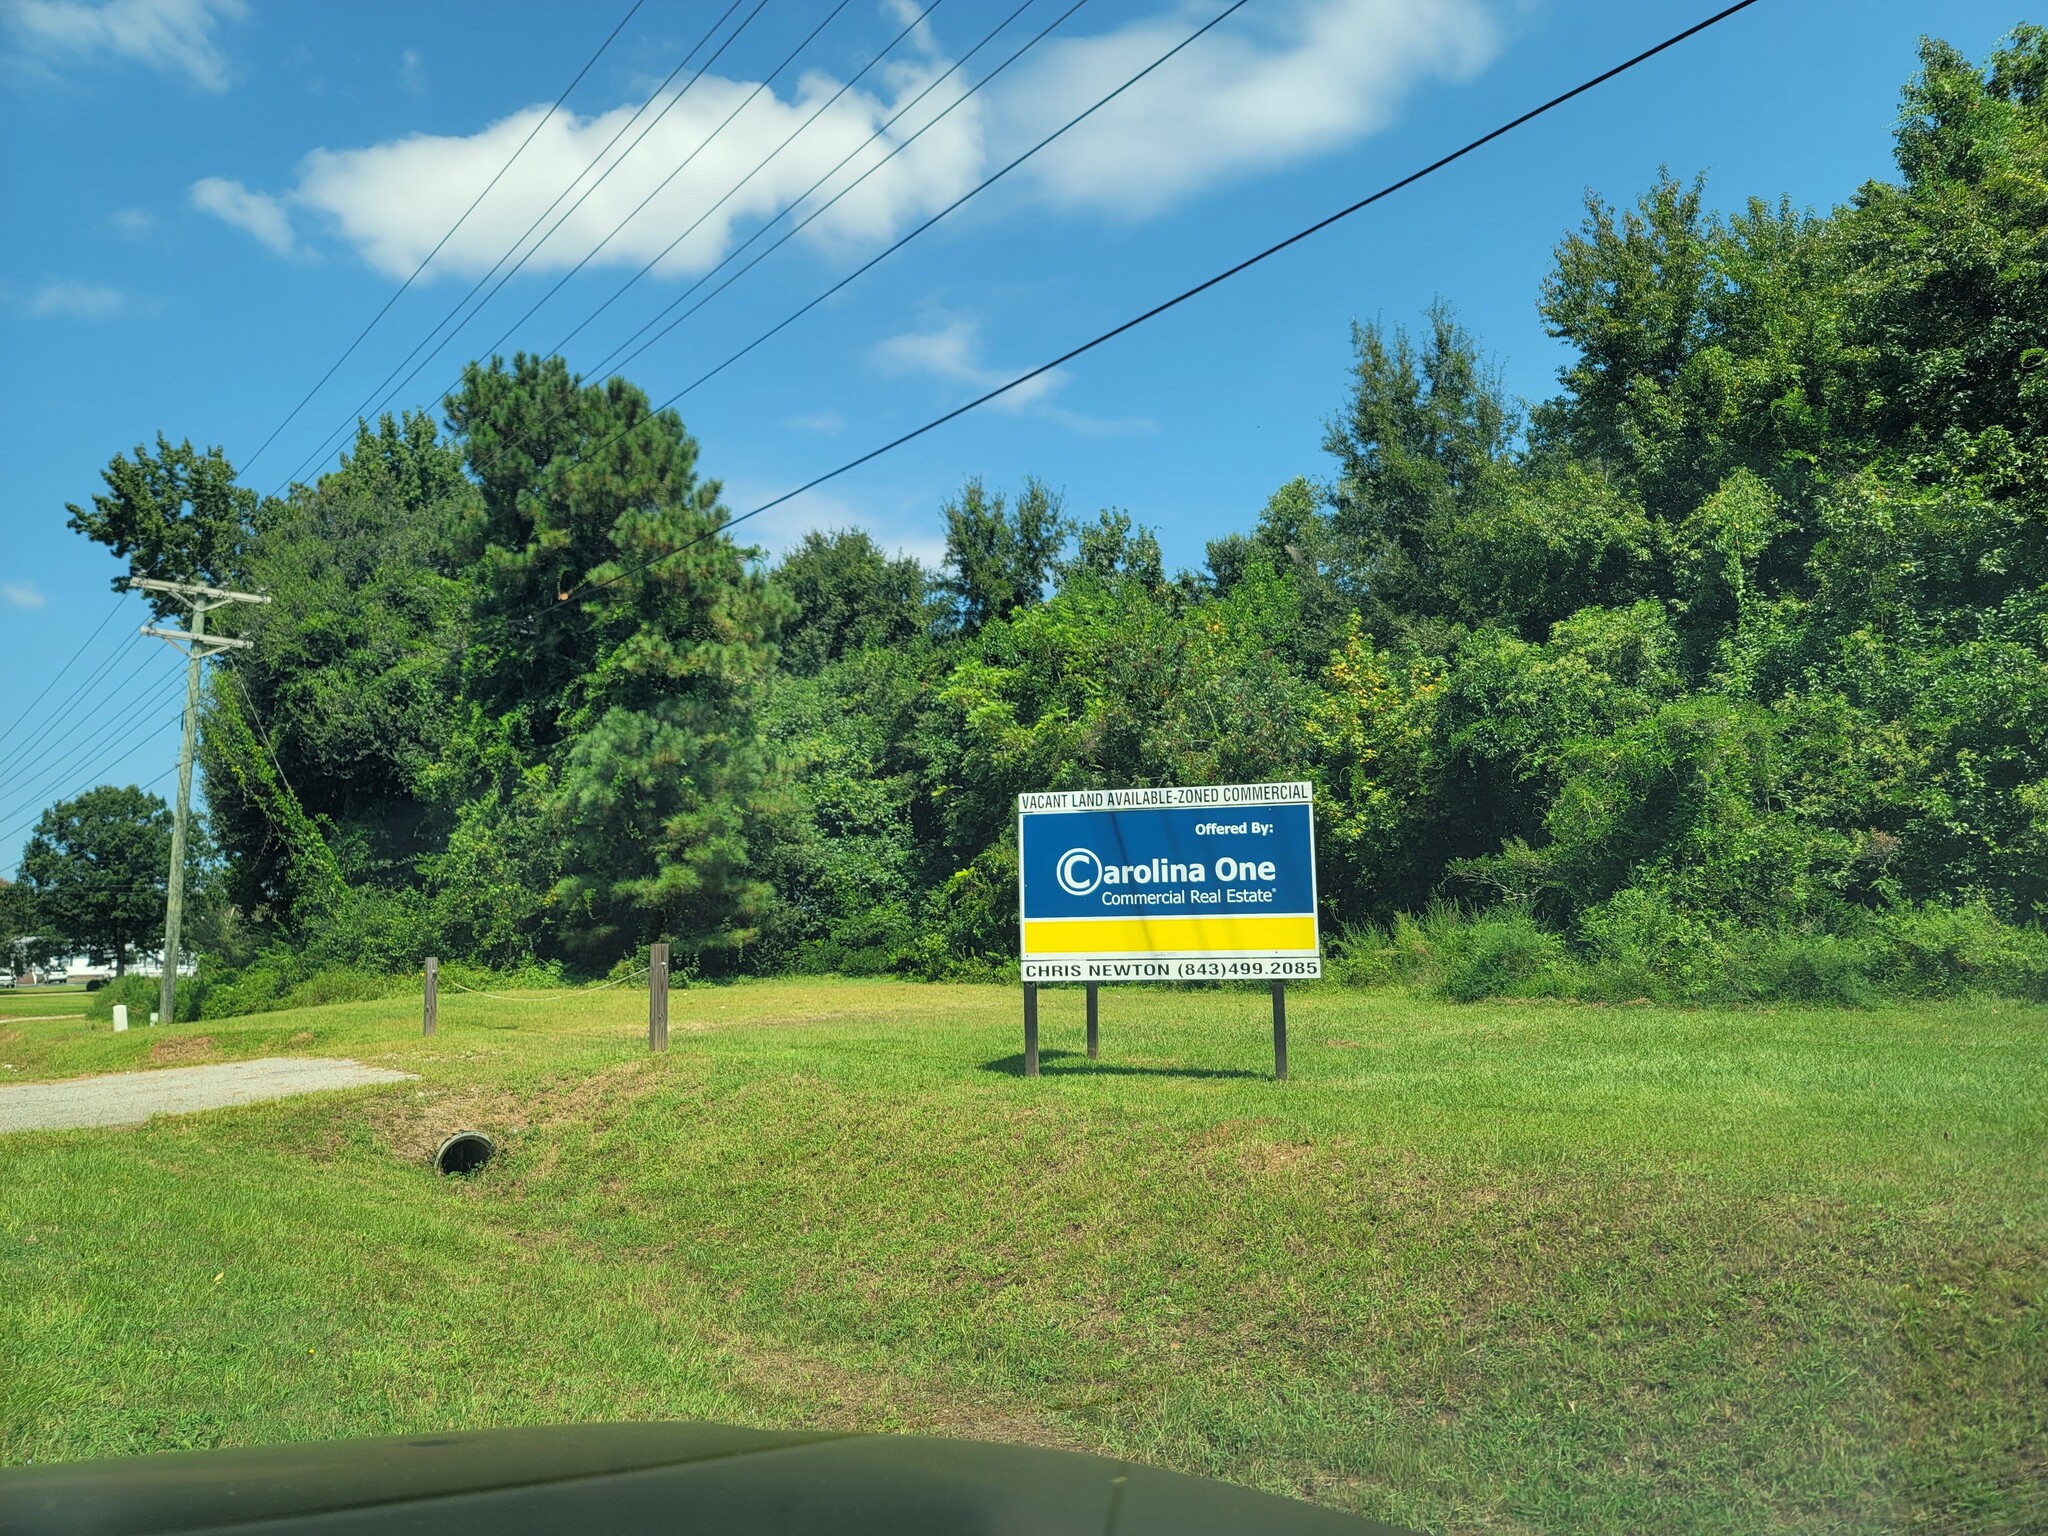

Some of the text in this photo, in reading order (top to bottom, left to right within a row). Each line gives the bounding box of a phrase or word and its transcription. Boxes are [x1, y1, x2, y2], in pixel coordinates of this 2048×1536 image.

[1022, 784, 1309, 809] VACANT LAND AVAILABLE-ZONED COMMERCIAL
[1195, 822, 1274, 836] Offered By:
[1057, 848, 1276, 895] Carolina One
[1102, 890, 1185, 907] Commercial
[1190, 889, 1221, 904] Real
[1026, 961, 1318, 978] CHRIS NEWTON (843)499.2085
